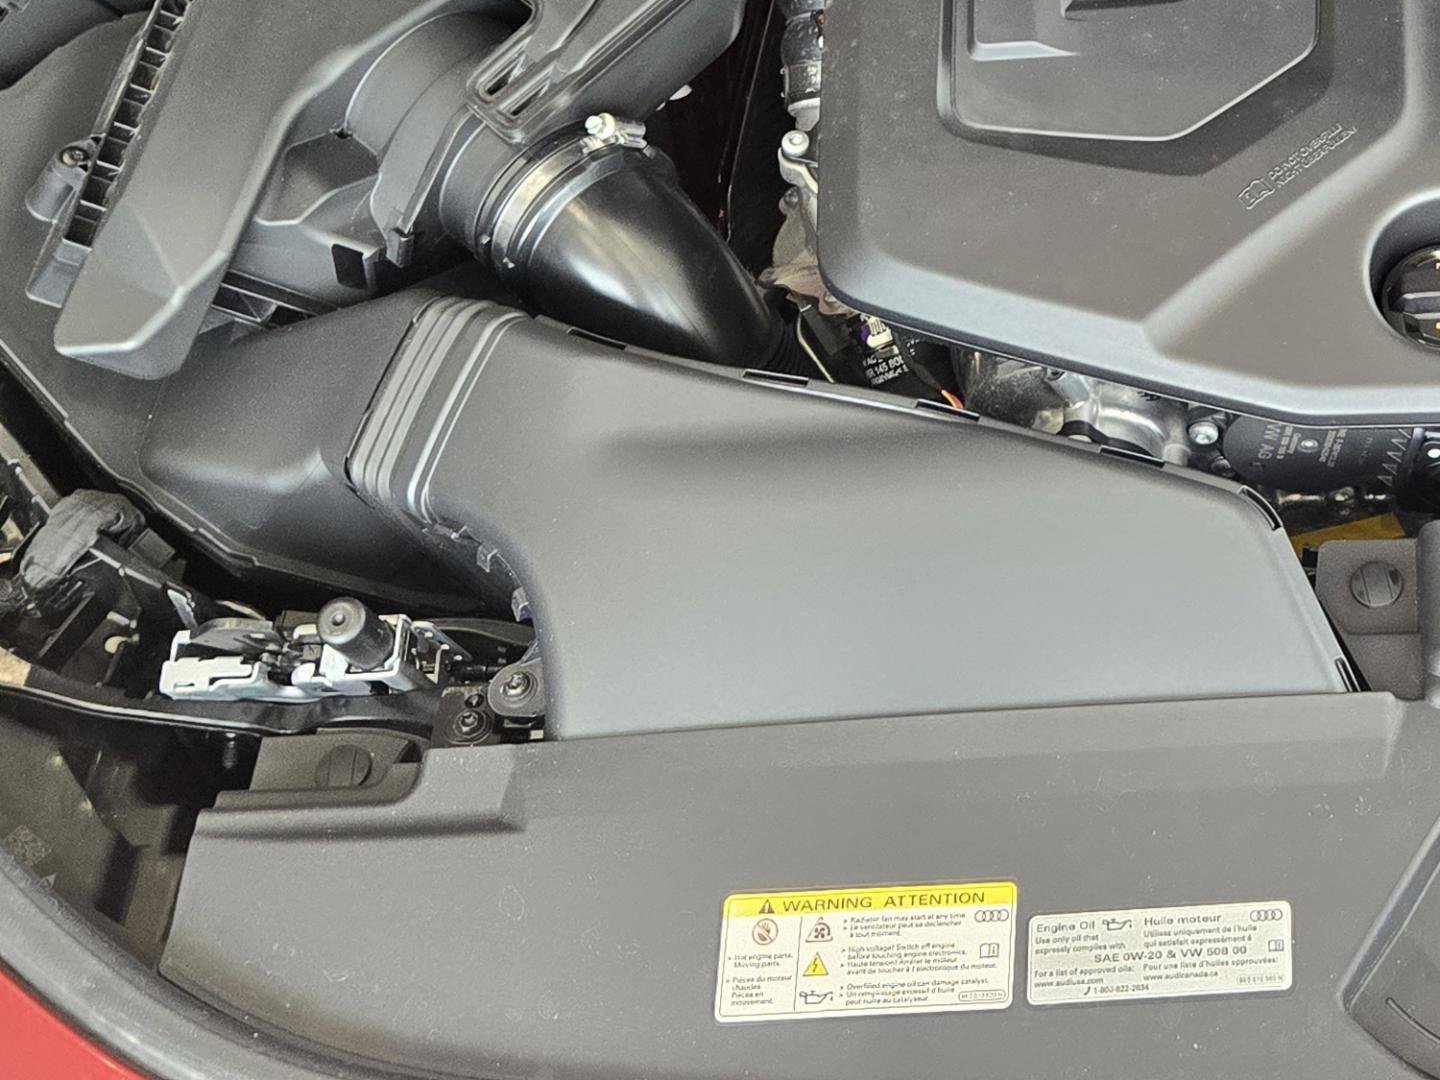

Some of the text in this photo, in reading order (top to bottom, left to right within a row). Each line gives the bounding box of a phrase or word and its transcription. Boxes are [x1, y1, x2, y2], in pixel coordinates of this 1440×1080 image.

[783, 892, 985, 912] WARNING ATTENTION
[1144, 914, 1222, 926] Huile moteur
[898, 922, 913, 930] peut
[1037, 921, 1095, 933] Engine Oil
[1174, 927, 1220, 936] uniquement
[903, 951, 927, 959] engine
[1035, 947, 1070, 955] expressly
[1073, 945, 1107, 953] complies
[1094, 946, 1247, 963] SAE 0W-20 & VW 508 00
[734, 960, 760, 968] Moving
[1143, 963, 1161, 971] Pour
[1164, 962, 1178, 970] une
[1079, 966, 1116, 976] approved
[882, 982, 906, 990] engine
[931, 979, 959, 987] damage
[1034, 977, 1104, 988] www.audiusa.com
